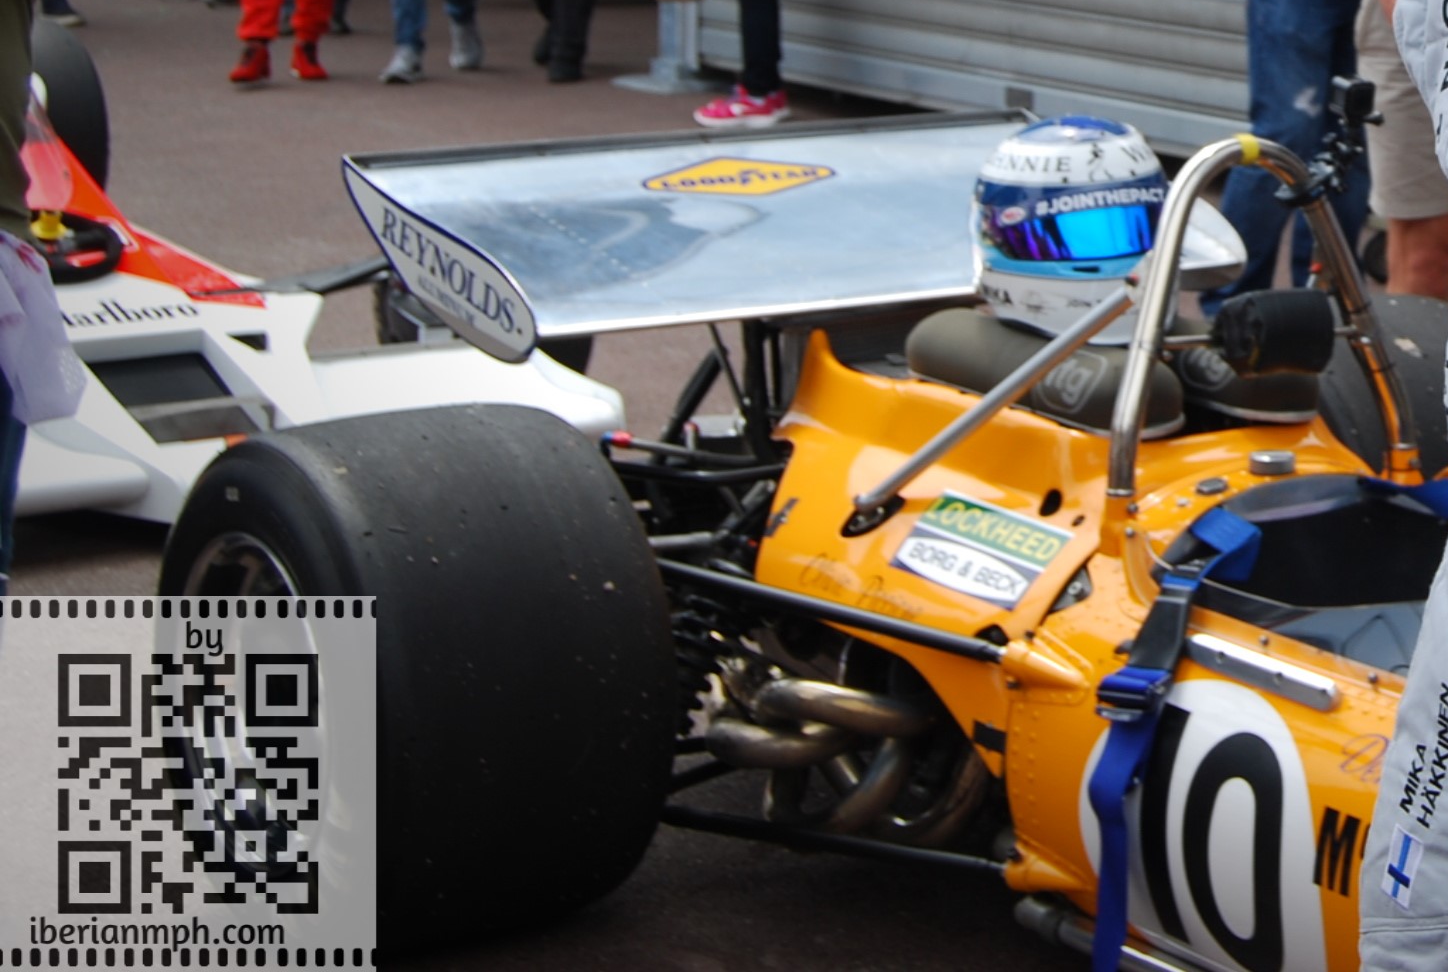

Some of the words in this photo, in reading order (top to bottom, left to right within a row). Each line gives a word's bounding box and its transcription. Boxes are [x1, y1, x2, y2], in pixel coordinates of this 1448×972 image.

[381, 207, 516, 333] REYNOLDS
[926, 497, 1062, 562] LOCKHEED
[909, 541, 958, 572] BORG
[958, 561, 974, 578] &
[974, 566, 1022, 596] BECK
[1400, 744, 1426, 813] MIKA
[1139, 702, 1284, 972] 10
